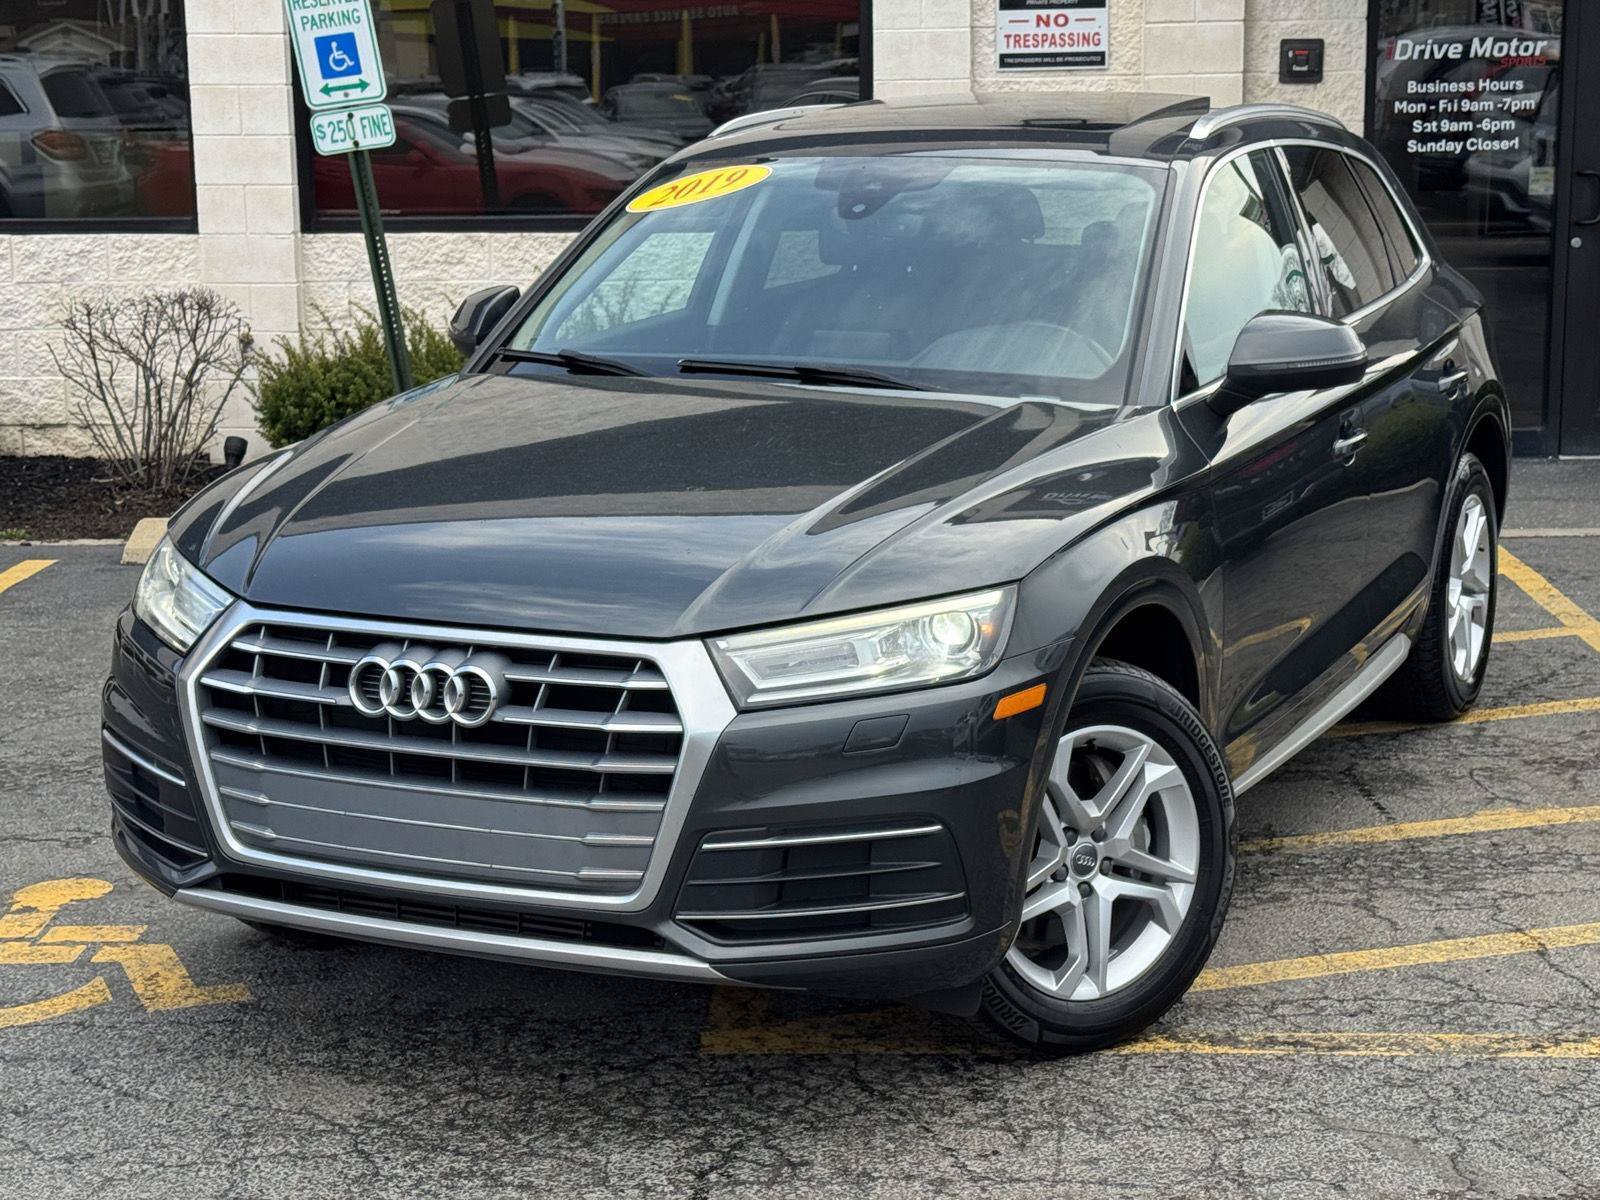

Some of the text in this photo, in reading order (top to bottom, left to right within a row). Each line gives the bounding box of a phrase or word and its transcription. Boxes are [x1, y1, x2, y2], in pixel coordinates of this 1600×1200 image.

[300, 8, 361, 31] PARKING
[1035, 13, 1069, 28] NO
[1003, 32, 1101, 49] TRESPASSING
[1385, 37, 1548, 61] iDrive Motor
[1064, 55, 1101, 63] PROSECUTED
[1499, 56, 1547, 68] SPORTS
[1407, 78, 1524, 94] Business Hours
[1394, 100, 1427, 114] Mon
[1439, 99, 1458, 113] Fri
[1460, 98, 1494, 112] 9am
[1497, 97, 1535, 113] -7pm
[360, 113, 391, 139] FINE
[1412, 117, 1516, 133] Sat 9am -6pm
[1407, 139, 1464, 154] Sunday
[647, 168, 749, 208] 2019
[1168, 699, 1232, 808] BRIDGESTONE
